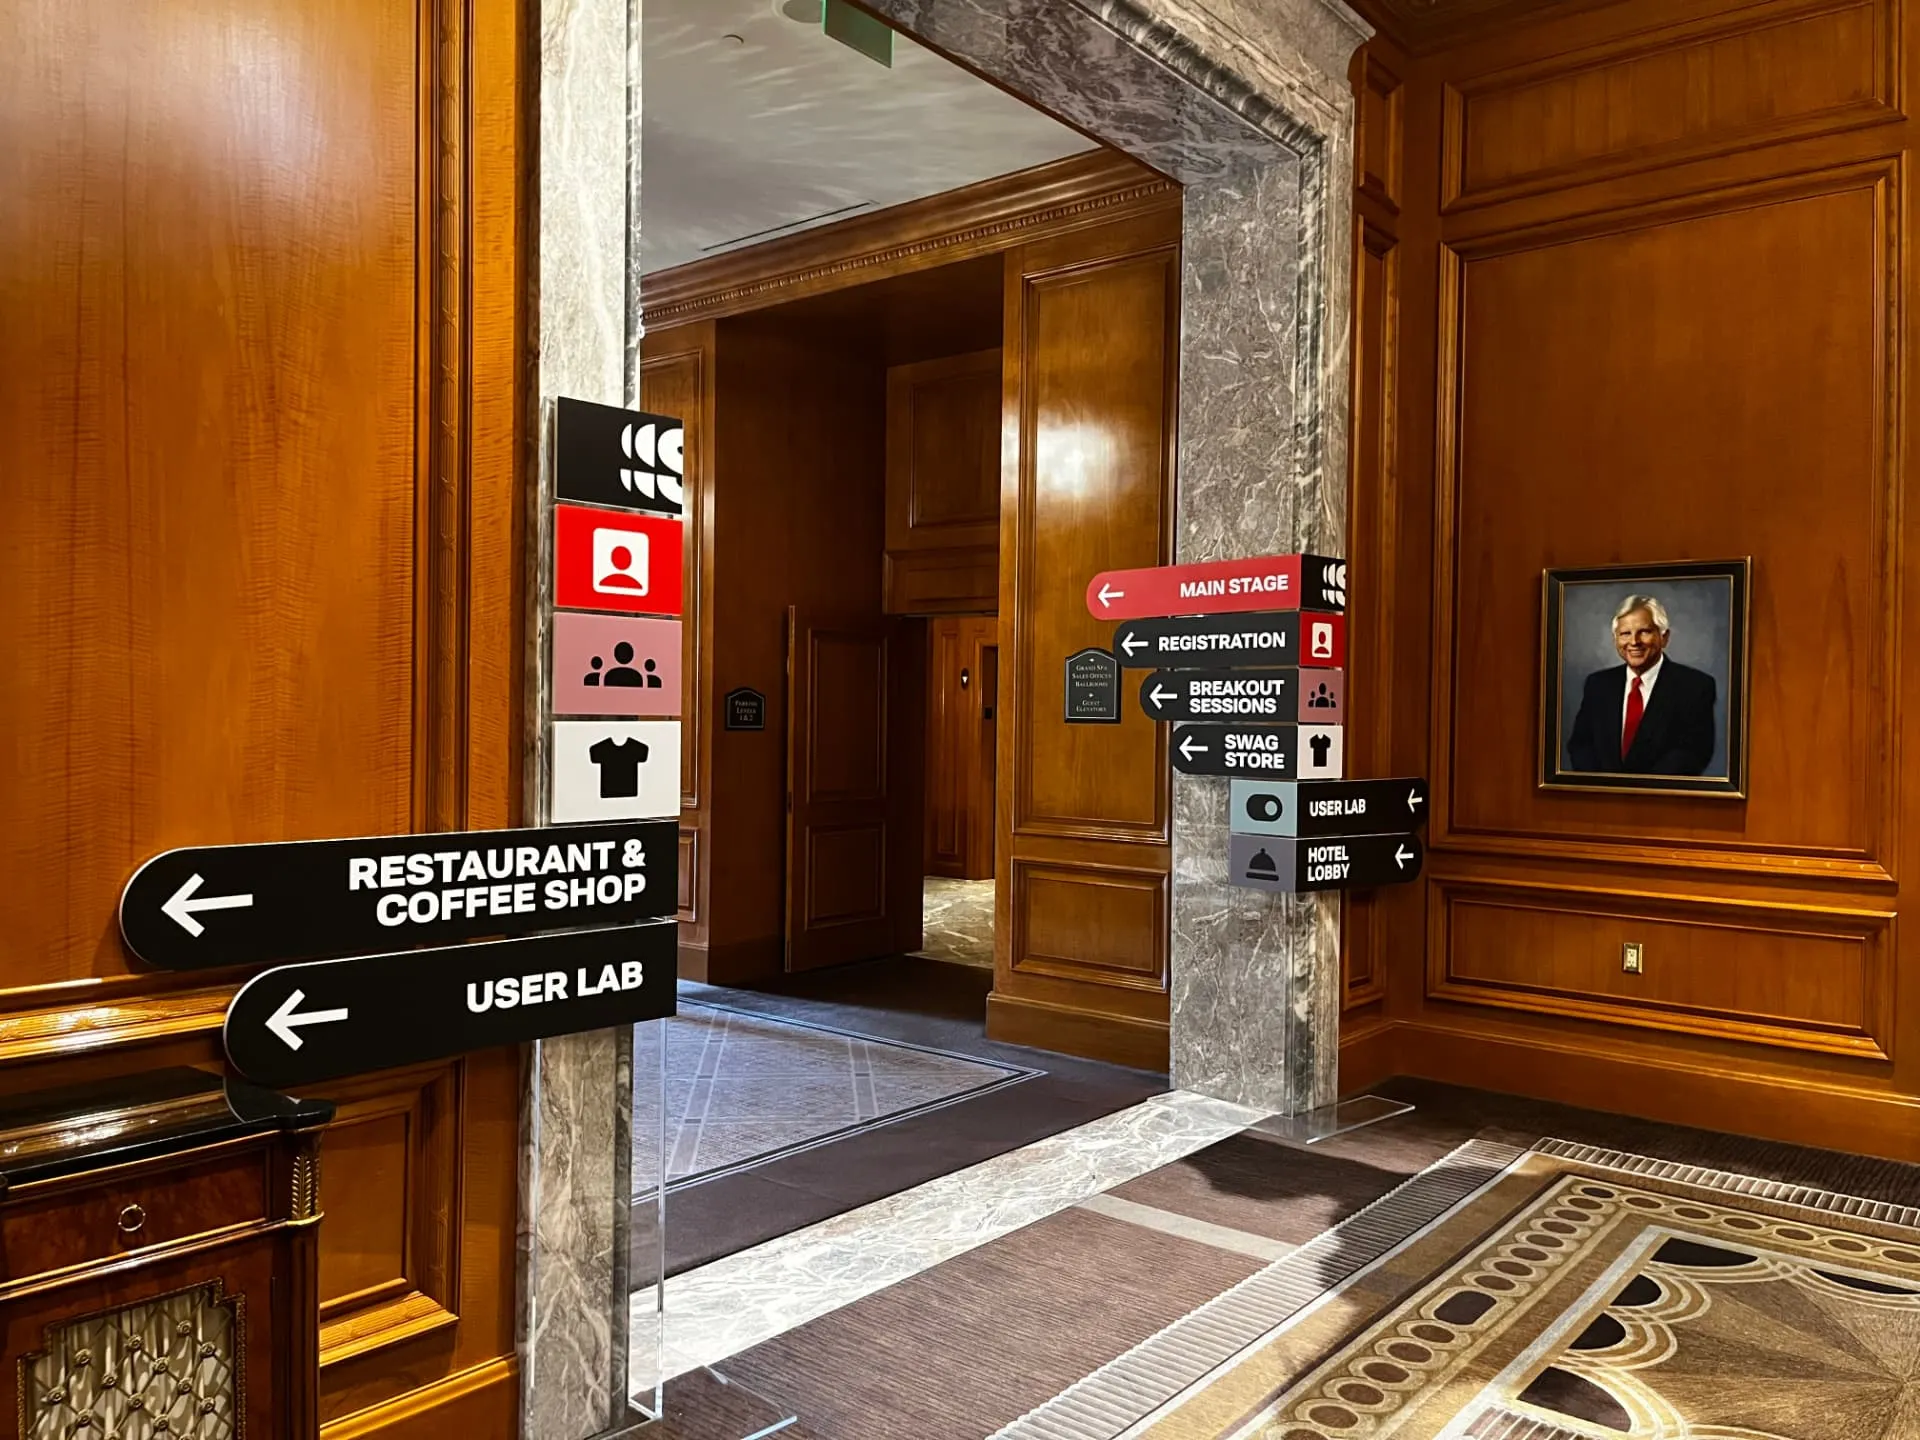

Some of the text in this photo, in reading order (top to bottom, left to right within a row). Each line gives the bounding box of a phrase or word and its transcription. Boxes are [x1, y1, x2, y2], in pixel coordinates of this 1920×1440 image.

[1180, 574, 1289, 598] MAIN STAGE
[1158, 631, 1286, 652] REGISTRATION
[1189, 679, 1285, 696] BREAKOUT
[1189, 697, 1277, 714] SESSIONS
[1224, 733, 1279, 751] SWAG
[1224, 751, 1285, 769] STORE
[1309, 798, 1366, 817] USER LAB
[1308, 845, 1349, 863] HOTEL
[349, 838, 646, 891] RESTAURANT &
[1307, 863, 1350, 882] LOBBY
[376, 873, 646, 927] COFFEE SHOP
[467, 960, 643, 1013] USER LAB
